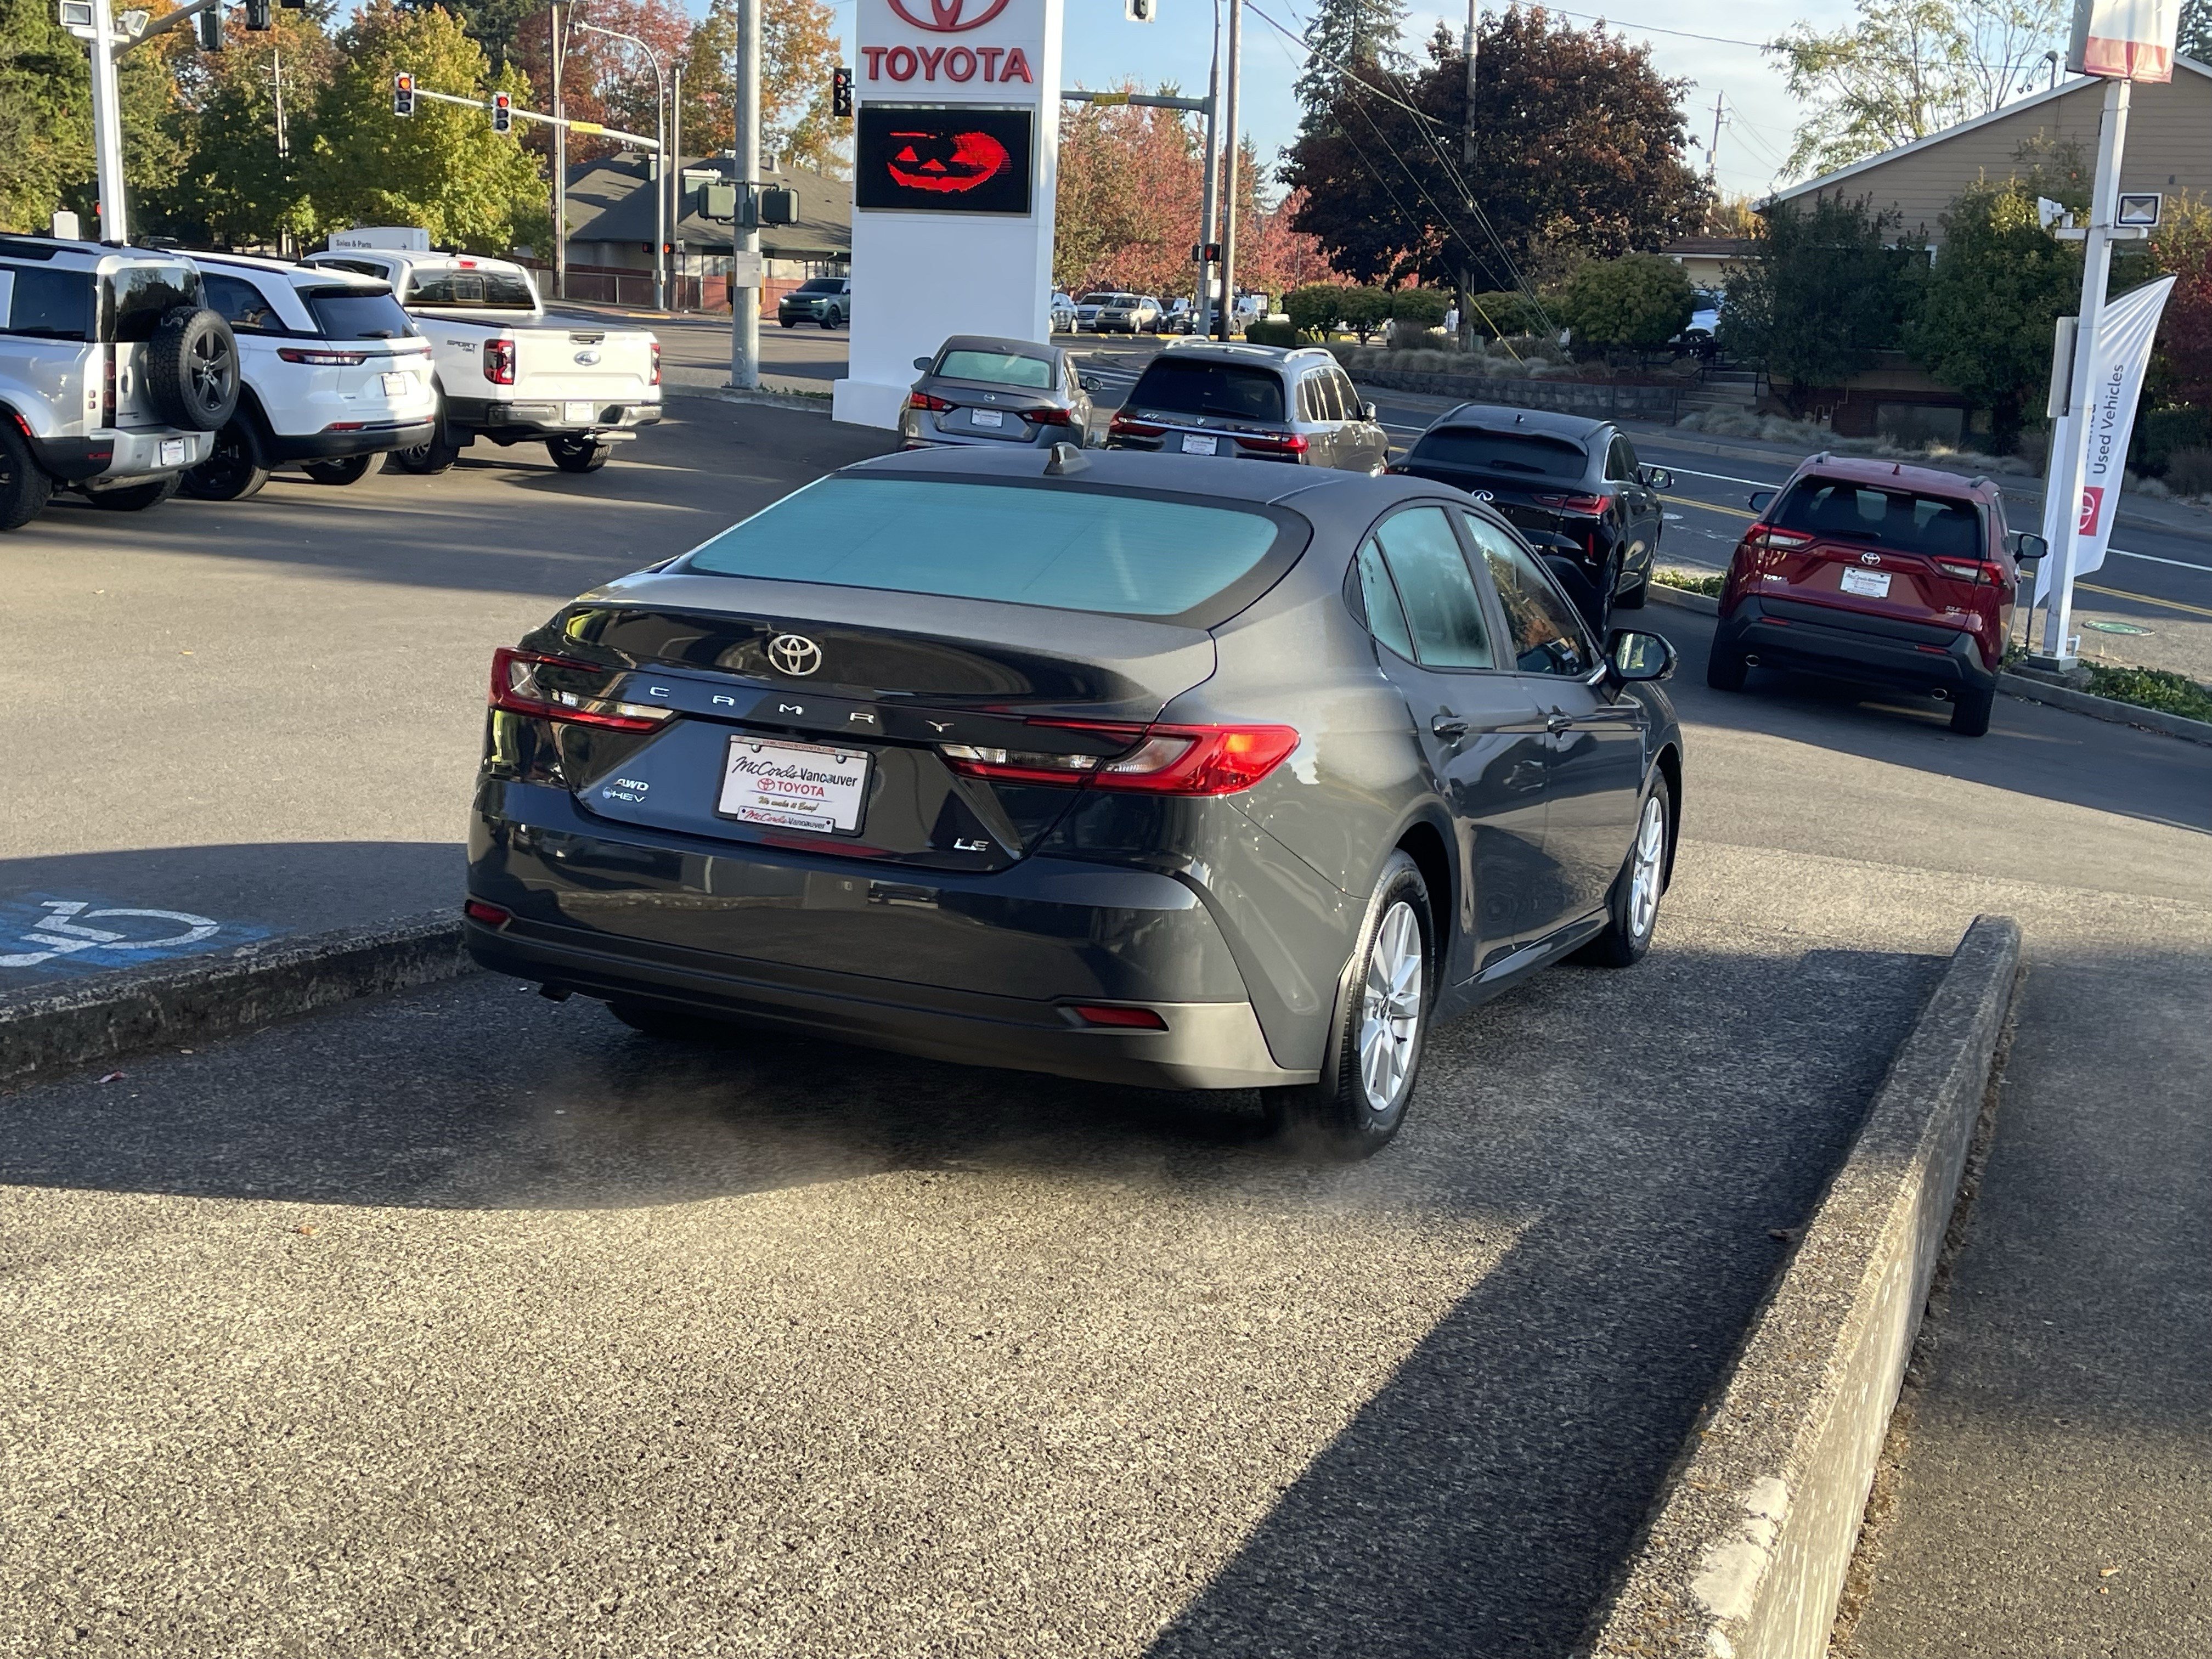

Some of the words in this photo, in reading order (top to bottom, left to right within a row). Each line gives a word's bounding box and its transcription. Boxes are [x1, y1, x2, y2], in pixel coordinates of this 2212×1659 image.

[861, 46, 1034, 83] TOYOTA
[2101, 364, 2124, 430] Vehicles
[2093, 434, 2112, 474] Used
[649, 686, 956, 732] CAMRY
[614, 778, 649, 791] AWD
[777, 781, 825, 797] TOYOTA
[953, 838, 989, 851] LE
